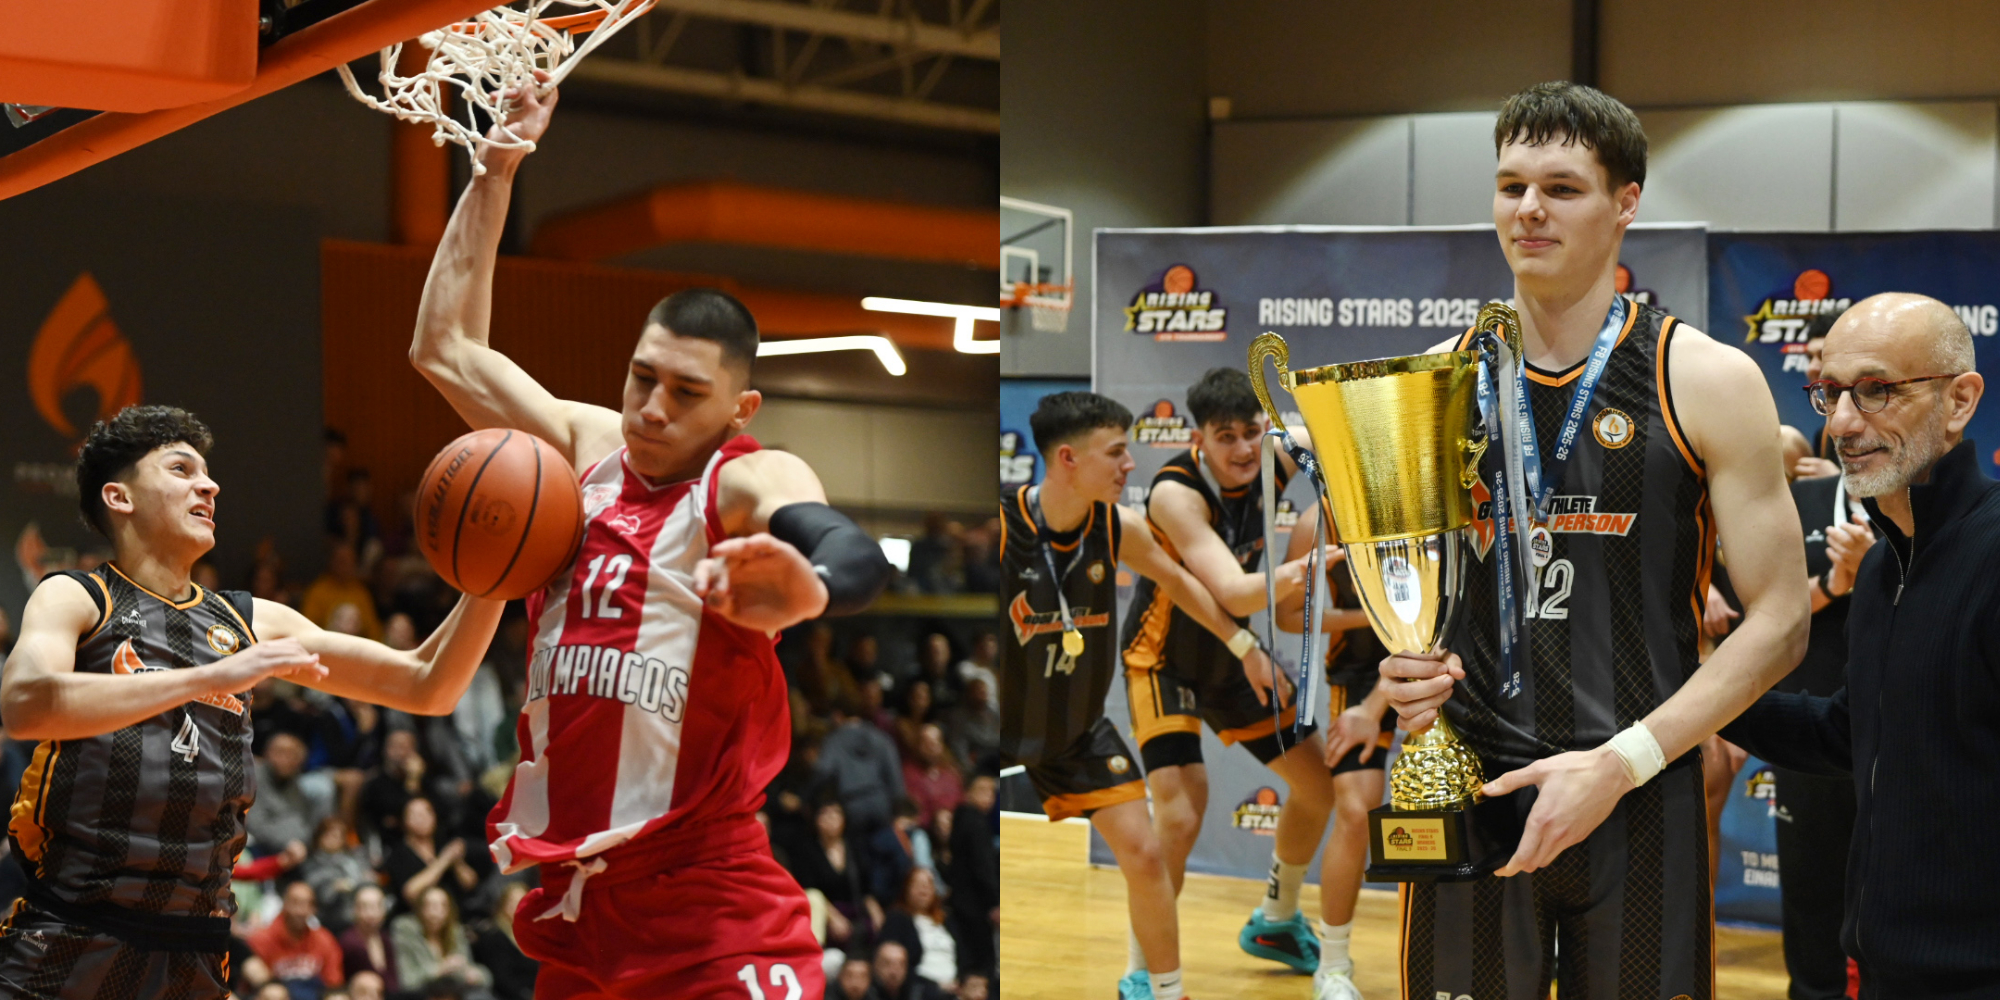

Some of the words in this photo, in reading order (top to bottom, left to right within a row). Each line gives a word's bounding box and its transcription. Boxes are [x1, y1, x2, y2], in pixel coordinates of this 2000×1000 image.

[1146, 291, 1212, 307] RISING
[1259, 298, 1334, 327] RISING
[1338, 298, 1413, 327] STARS
[1772, 298, 1850, 314] RISING
[1137, 309, 1226, 332] STARS
[1595, 345, 1608, 359] F8
[1582, 359, 1602, 388] RISING
[1570, 388, 1590, 420] STARS
[1138, 428, 1192, 442] STARS
[1517, 412, 1532, 442] RISING
[1556, 420, 1579, 461] 2025-26
[1521, 444, 1535, 457] F8
[1549, 498, 1592, 514] THLETE
[1500, 517, 1508, 548] STARS
[1553, 513, 1633, 534] PERSON
[1503, 551, 1511, 583] RISING
[582, 553, 633, 619] 12
[1044, 643, 1076, 678] 14
[171, 712, 199, 763] 4
[737, 963, 803, 1000] 12
